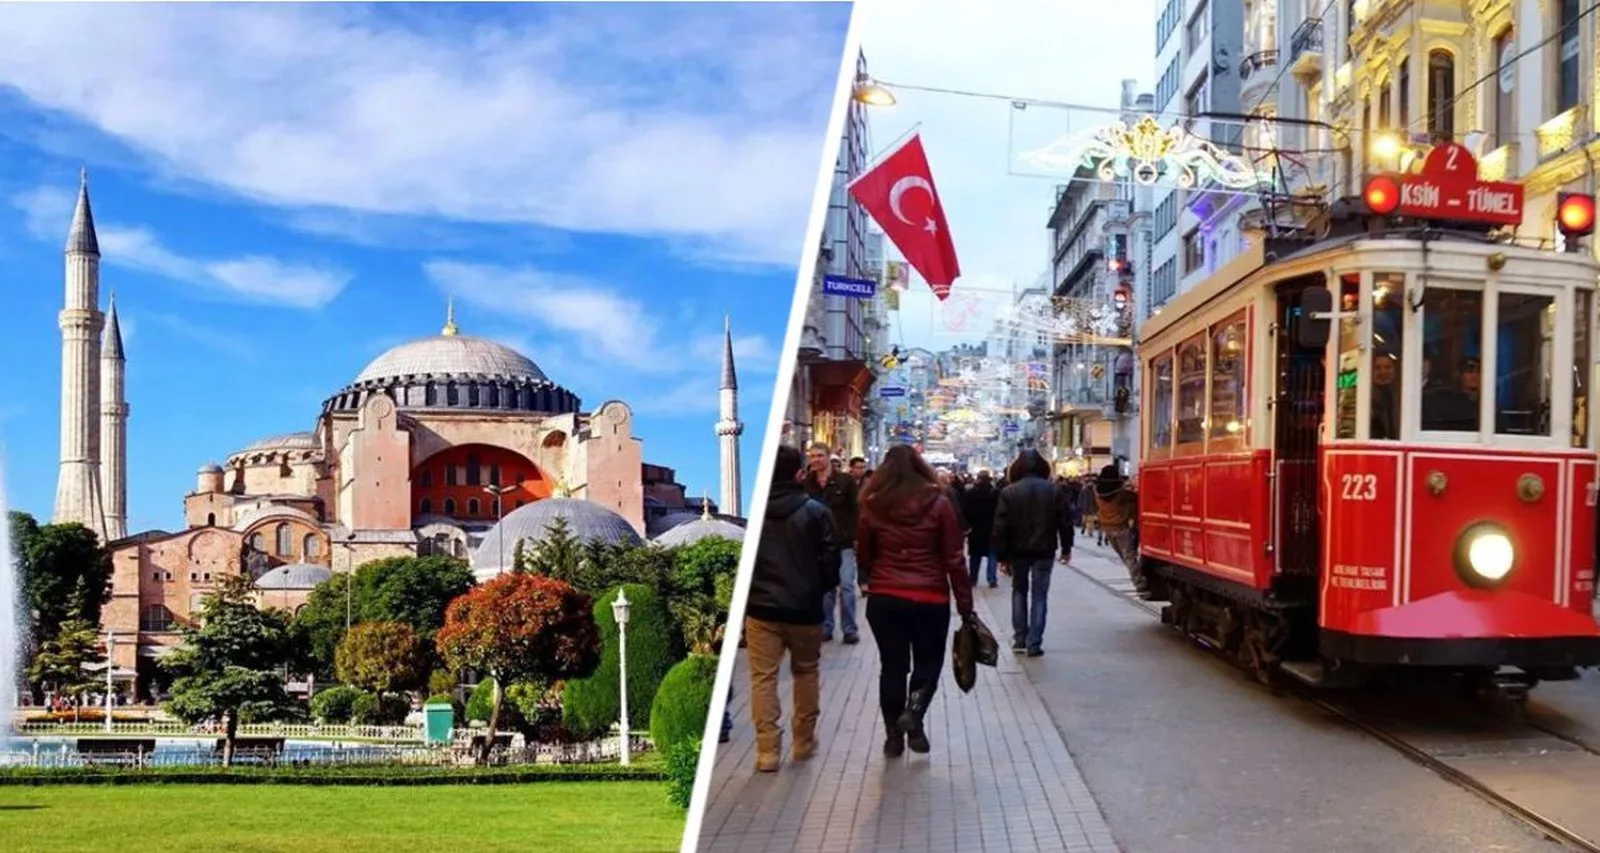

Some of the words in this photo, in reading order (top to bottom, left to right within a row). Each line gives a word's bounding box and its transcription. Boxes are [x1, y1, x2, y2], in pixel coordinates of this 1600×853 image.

[1446, 145, 1459, 170] 2
[1401, 182, 1440, 208] KSİM
[1467, 186, 1519, 215] TÜNEL
[827, 281, 873, 294] TURKCELL
[1342, 474, 1377, 500] 223
